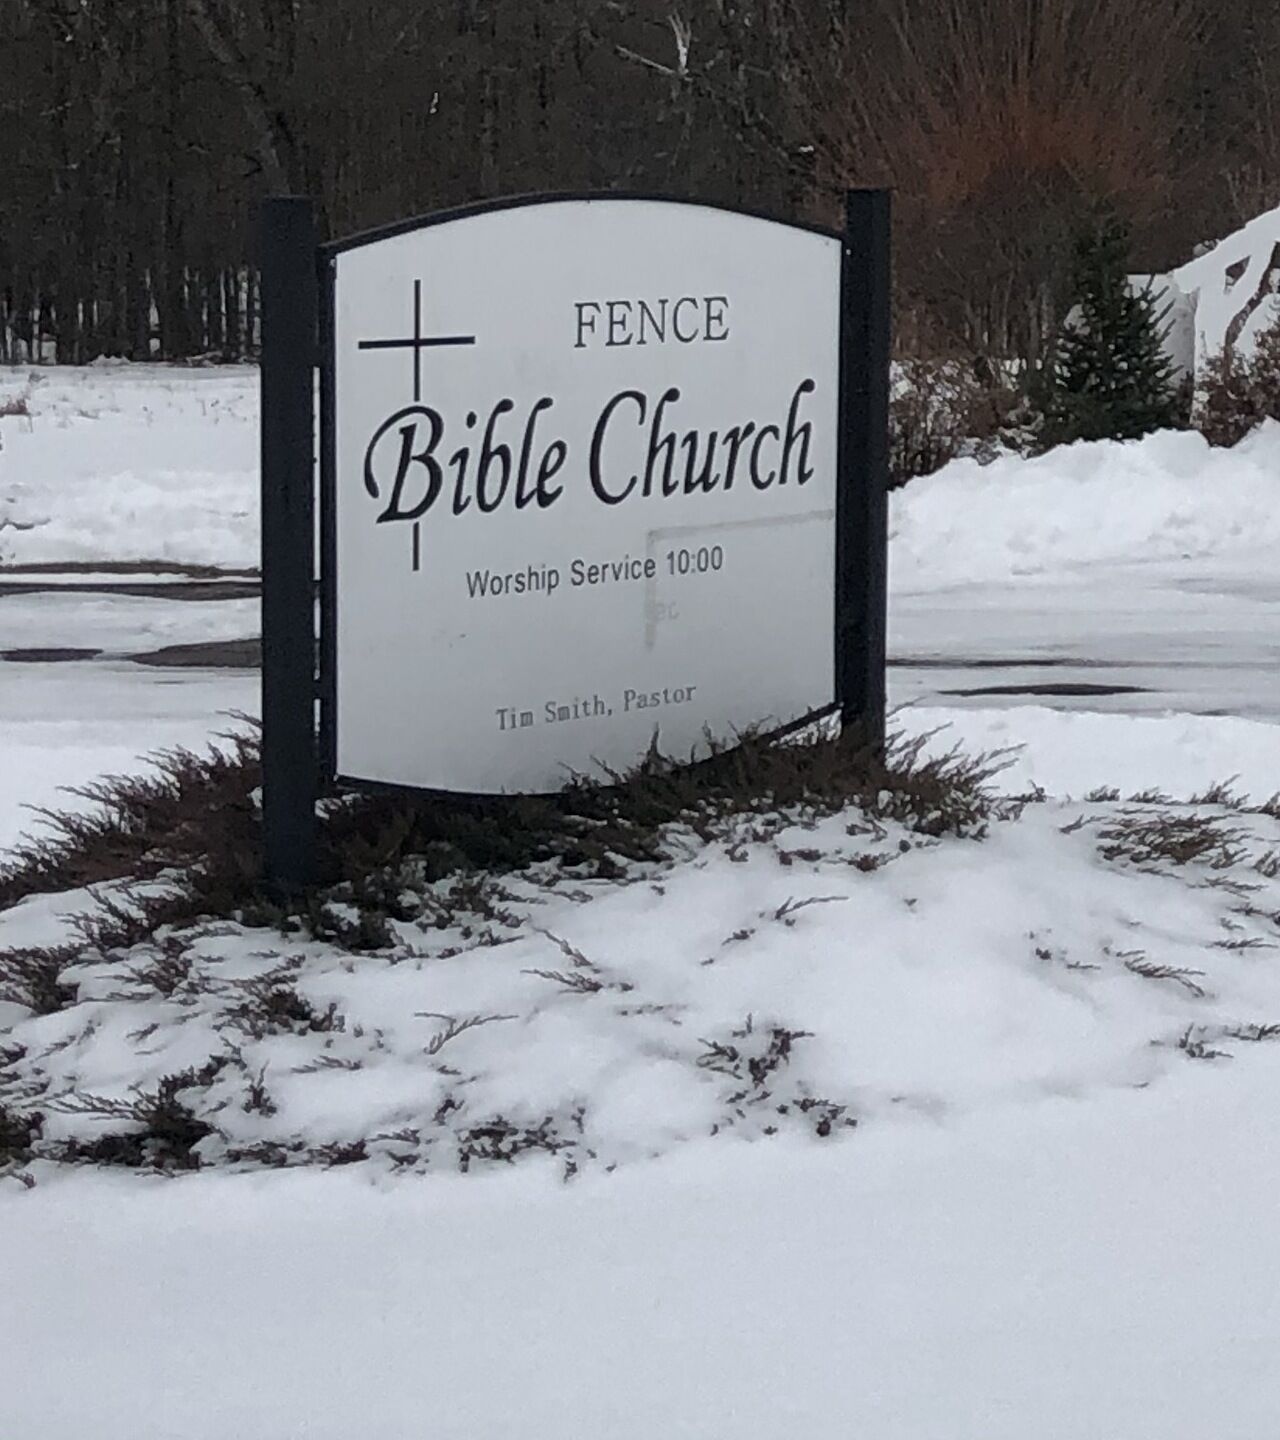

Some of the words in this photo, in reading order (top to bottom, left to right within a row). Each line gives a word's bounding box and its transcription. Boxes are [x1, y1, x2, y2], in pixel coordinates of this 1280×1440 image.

[574, 296, 729, 348] FENCE
[364, 397, 567, 524] Bible
[589, 379, 816, 505] Church
[466, 563, 560, 598] Worship
[570, 552, 657, 587] Service
[666, 546, 723, 576] 10:00
[495, 707, 534, 731] Tim
[544, 695, 614, 725] Smith,
[624, 686, 697, 712] Pastor
